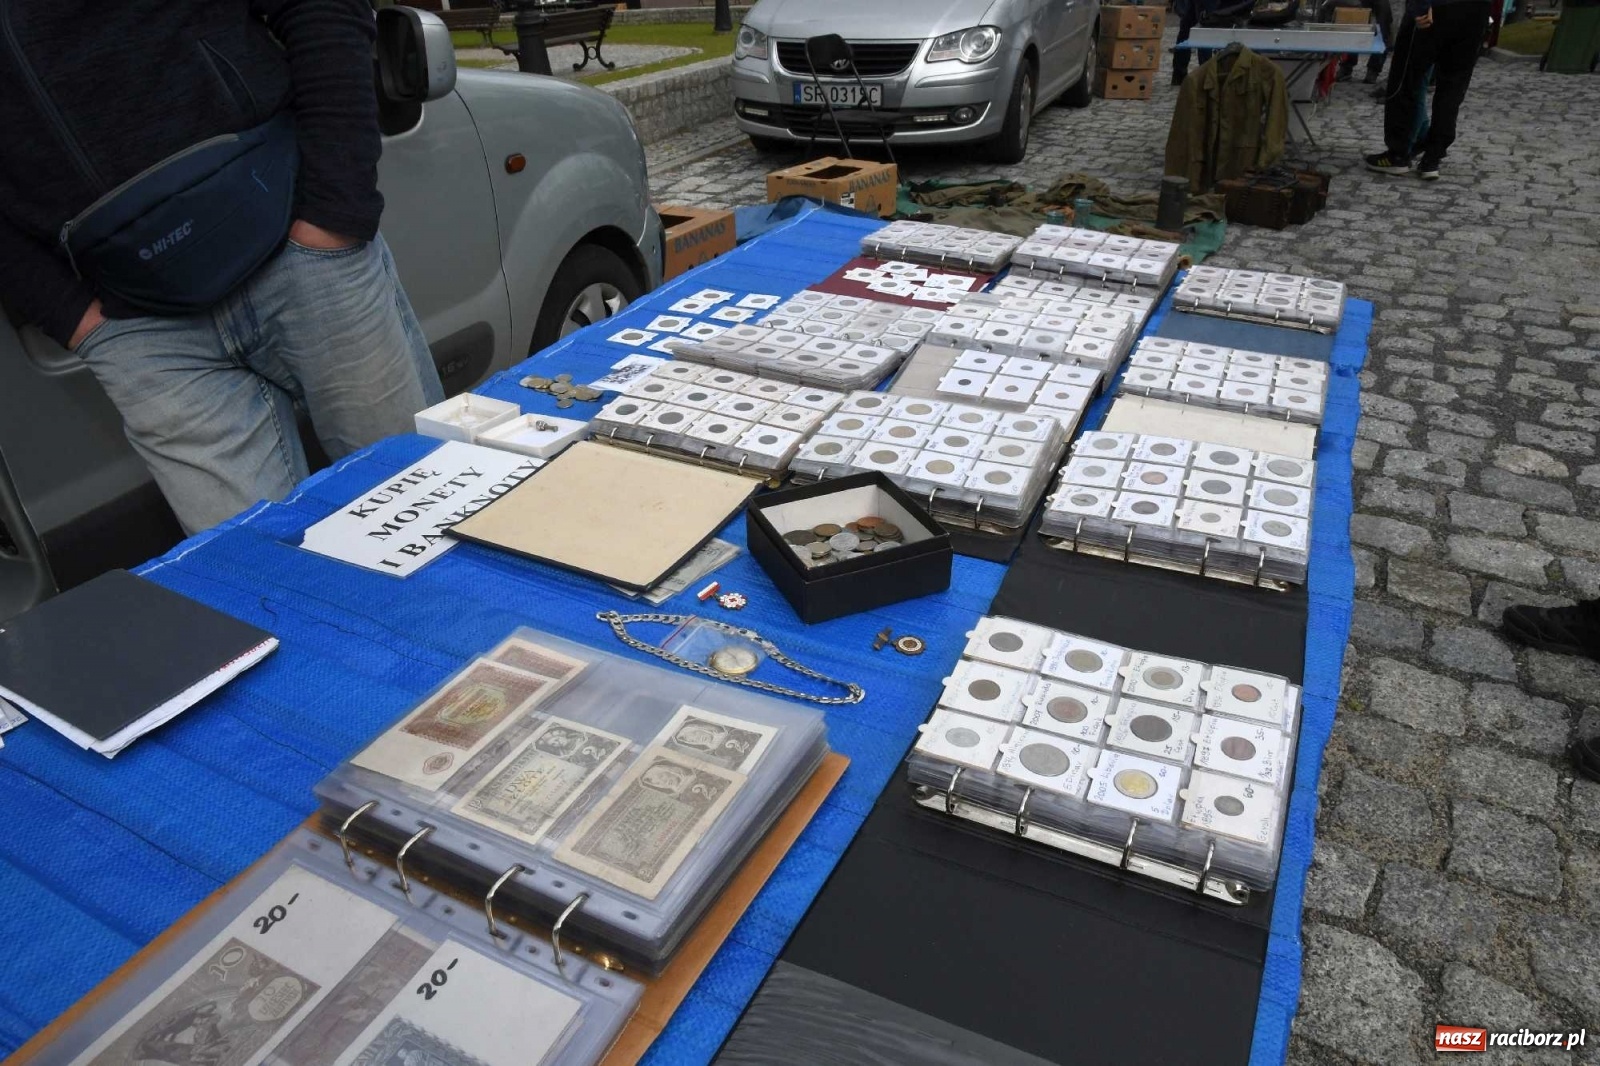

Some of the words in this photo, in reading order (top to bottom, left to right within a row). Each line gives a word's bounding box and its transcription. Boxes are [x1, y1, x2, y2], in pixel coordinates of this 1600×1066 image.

[849, 169, 891, 193] BANANAS
[152, 222, 192, 255] HI-TEC
[674, 219, 727, 253] BANANAS
[348, 468, 442, 519] KUPIĘ
[365, 466, 485, 541] MONETY
[377, 558, 404, 569] I
[398, 459, 540, 557] BANKNOTY
[253, 892, 300, 935] 20-
[208, 945, 246, 982] 10
[416, 958, 459, 1000] 20-
